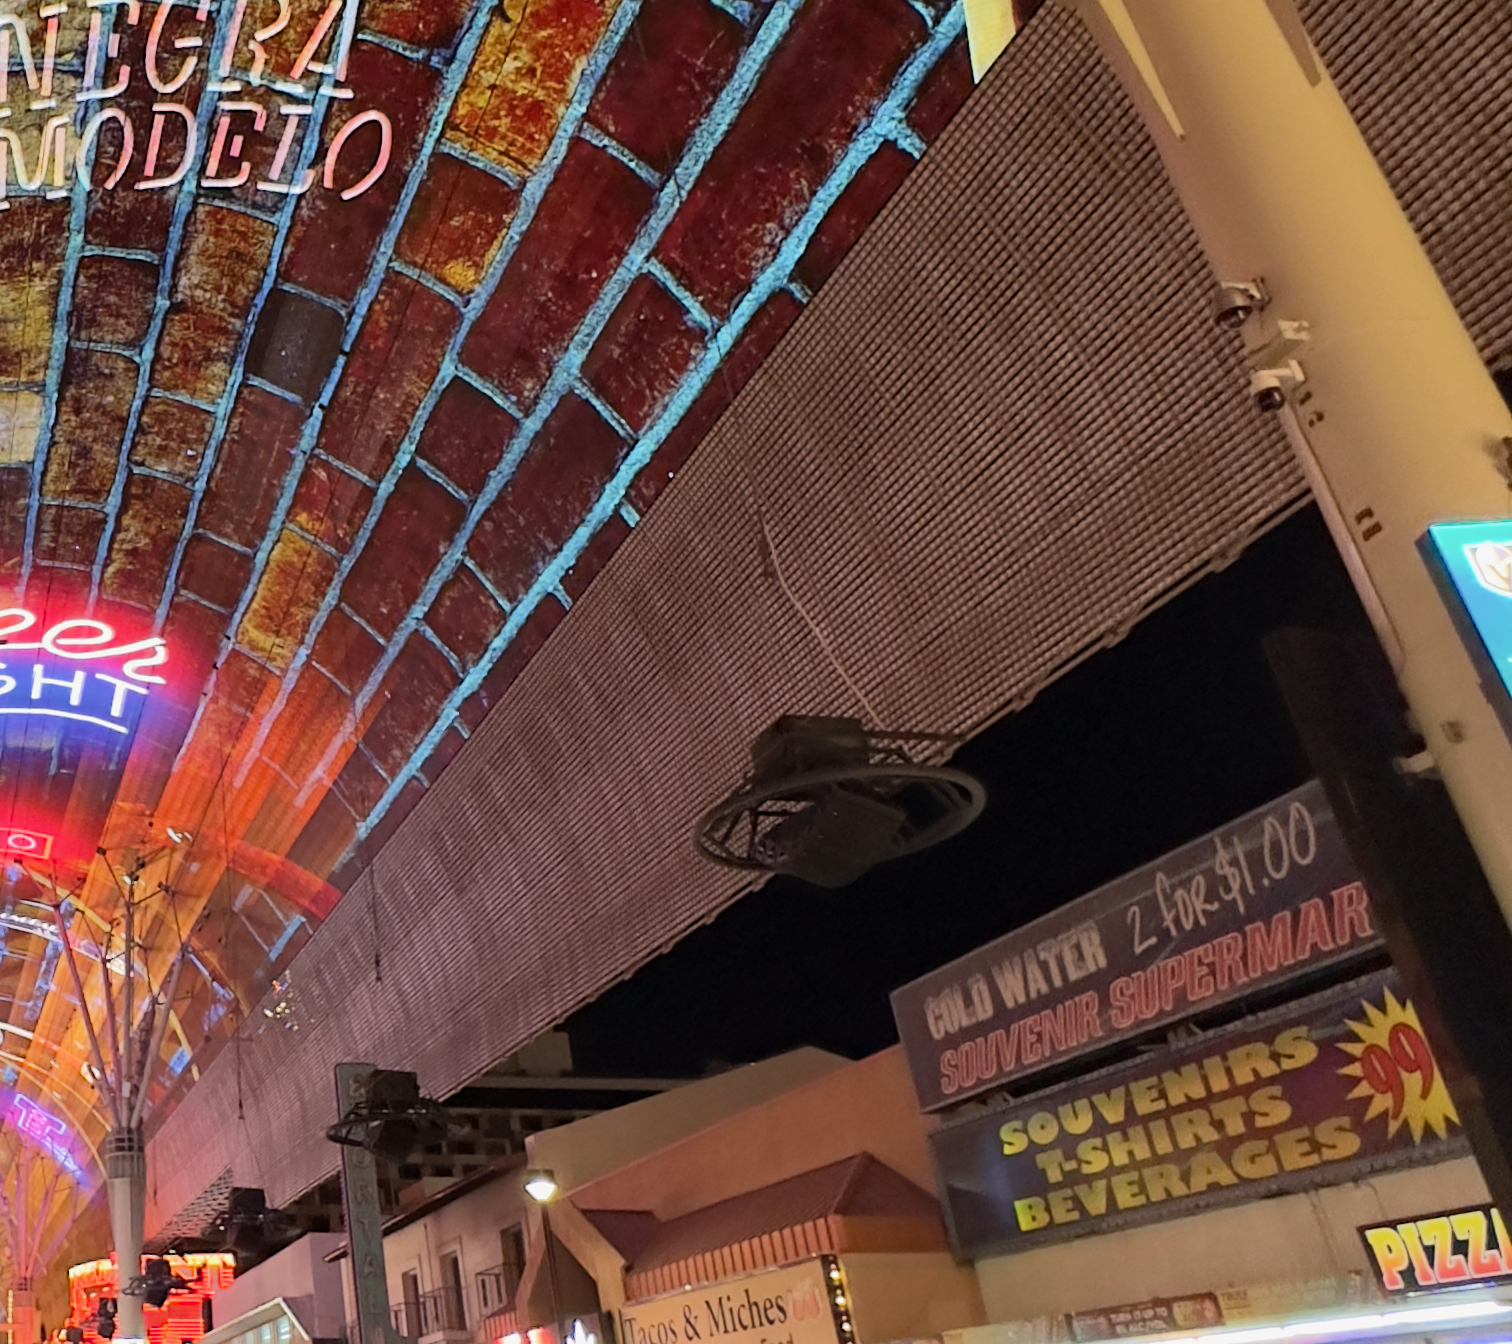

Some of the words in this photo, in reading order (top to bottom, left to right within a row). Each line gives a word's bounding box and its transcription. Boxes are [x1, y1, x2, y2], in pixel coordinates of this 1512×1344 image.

[1127, 905, 1157, 955] 2
[1213, 800, 1317, 915] $1.00
[923, 972, 994, 1040] COLD
[991, 918, 1108, 1010] WATER
[939, 991, 1104, 1095] SOUVENIR
[999, 1025, 1320, 1156] SOUVENIRS
[1360, 1021, 1435, 1121] 99
[1013, 1115, 1361, 1233] BEVERAGES
[1035, 1085, 1293, 1184] T-SHIRTS
[683, 1304, 702, 1342] &
[704, 1288, 788, 1338] Miches
